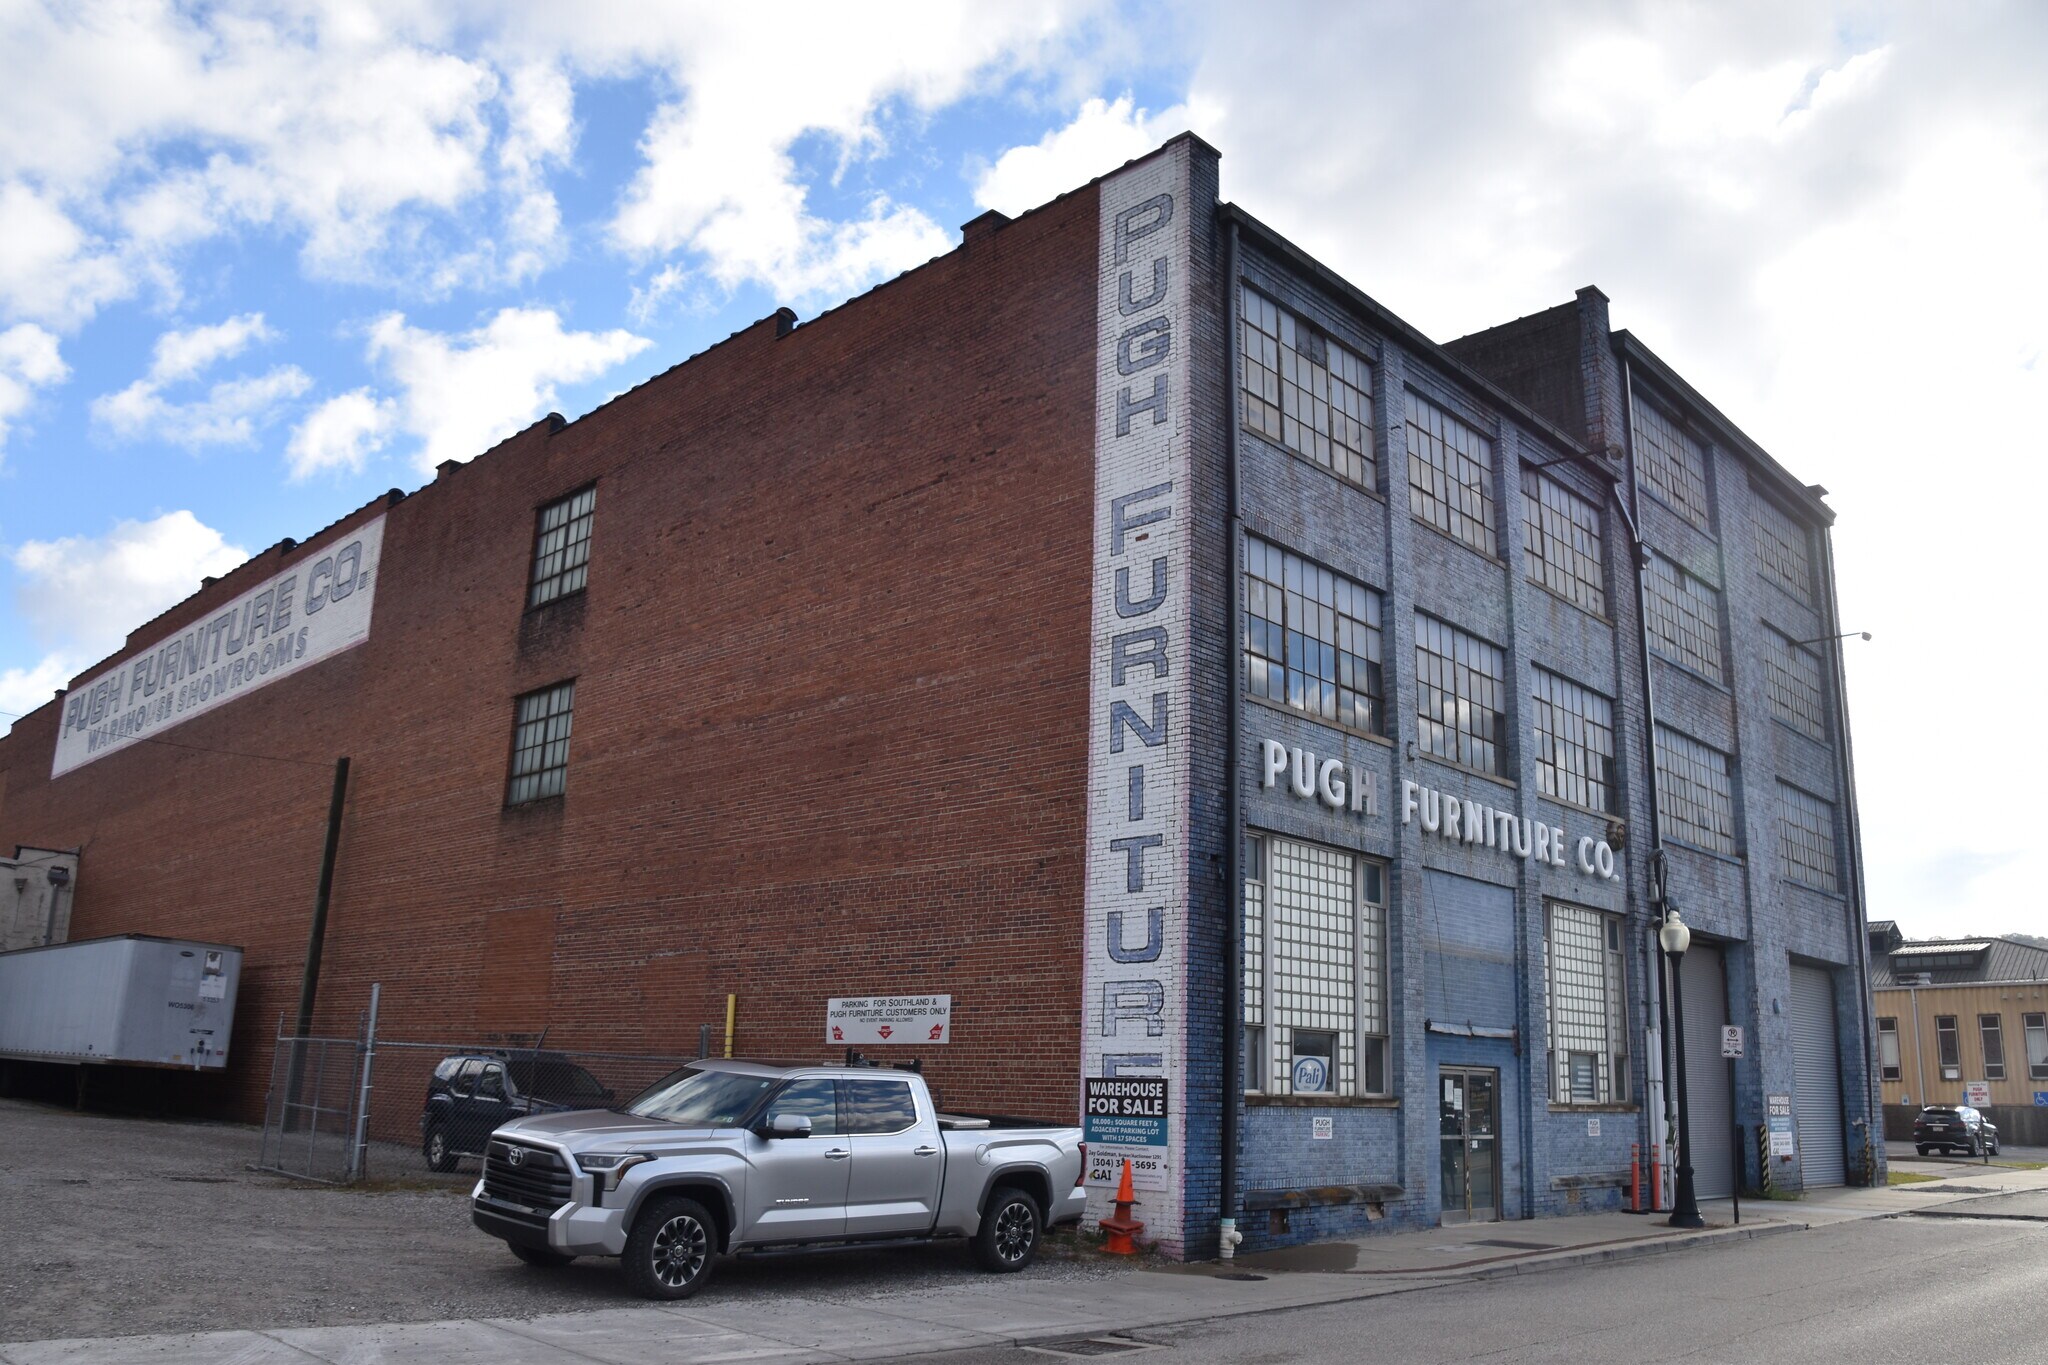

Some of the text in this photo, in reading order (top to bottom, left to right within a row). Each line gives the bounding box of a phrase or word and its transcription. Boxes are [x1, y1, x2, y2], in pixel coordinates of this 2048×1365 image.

[1114, 193, 1174, 438] PUGH
[63, 540, 368, 739] PUGH FURNITURE CO.
[87, 626, 309, 754] WAREHOUSE SHOWROOMS
[1263, 738, 1620, 883] PUGH FURNITURE CO.
[841, 1000, 869, 1008] PARKING
[873, 999, 887, 1007] FOR
[888, 998, 930, 1007] SOUTHLAND
[830, 1007, 947, 1018] PUGH FURNITURE CUSTOMERS ONLY
[1298, 1067, 1320, 1085] Pali
[1090, 1082, 1163, 1097] WAREHOUSE
[1088, 1098, 1163, 1115] FOR SALE
[1769, 1096, 1790, 1105] WAREHOUSE
[1769, 1105, 1790, 1115] FOR SALE
[1092, 1157, 1157, 1170] (304) 34-5695
[1093, 1168, 1112, 1180] GAI
